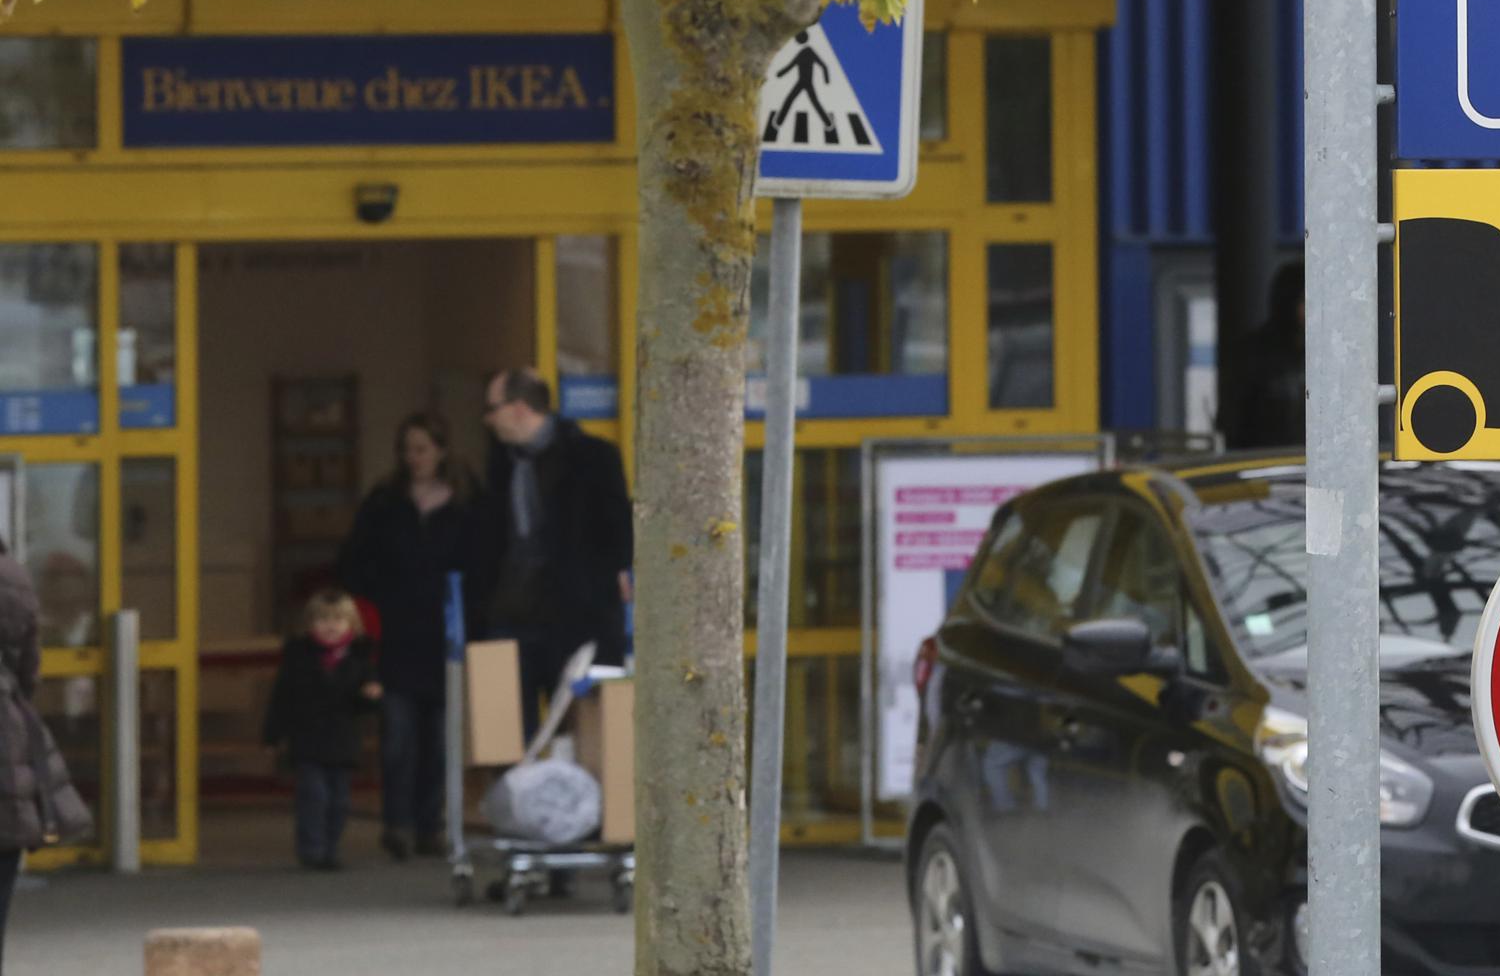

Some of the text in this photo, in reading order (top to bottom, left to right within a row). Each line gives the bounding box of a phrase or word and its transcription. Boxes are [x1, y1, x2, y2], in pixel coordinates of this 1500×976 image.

[142, 65, 588, 112] Bienvenue chez IKEA
